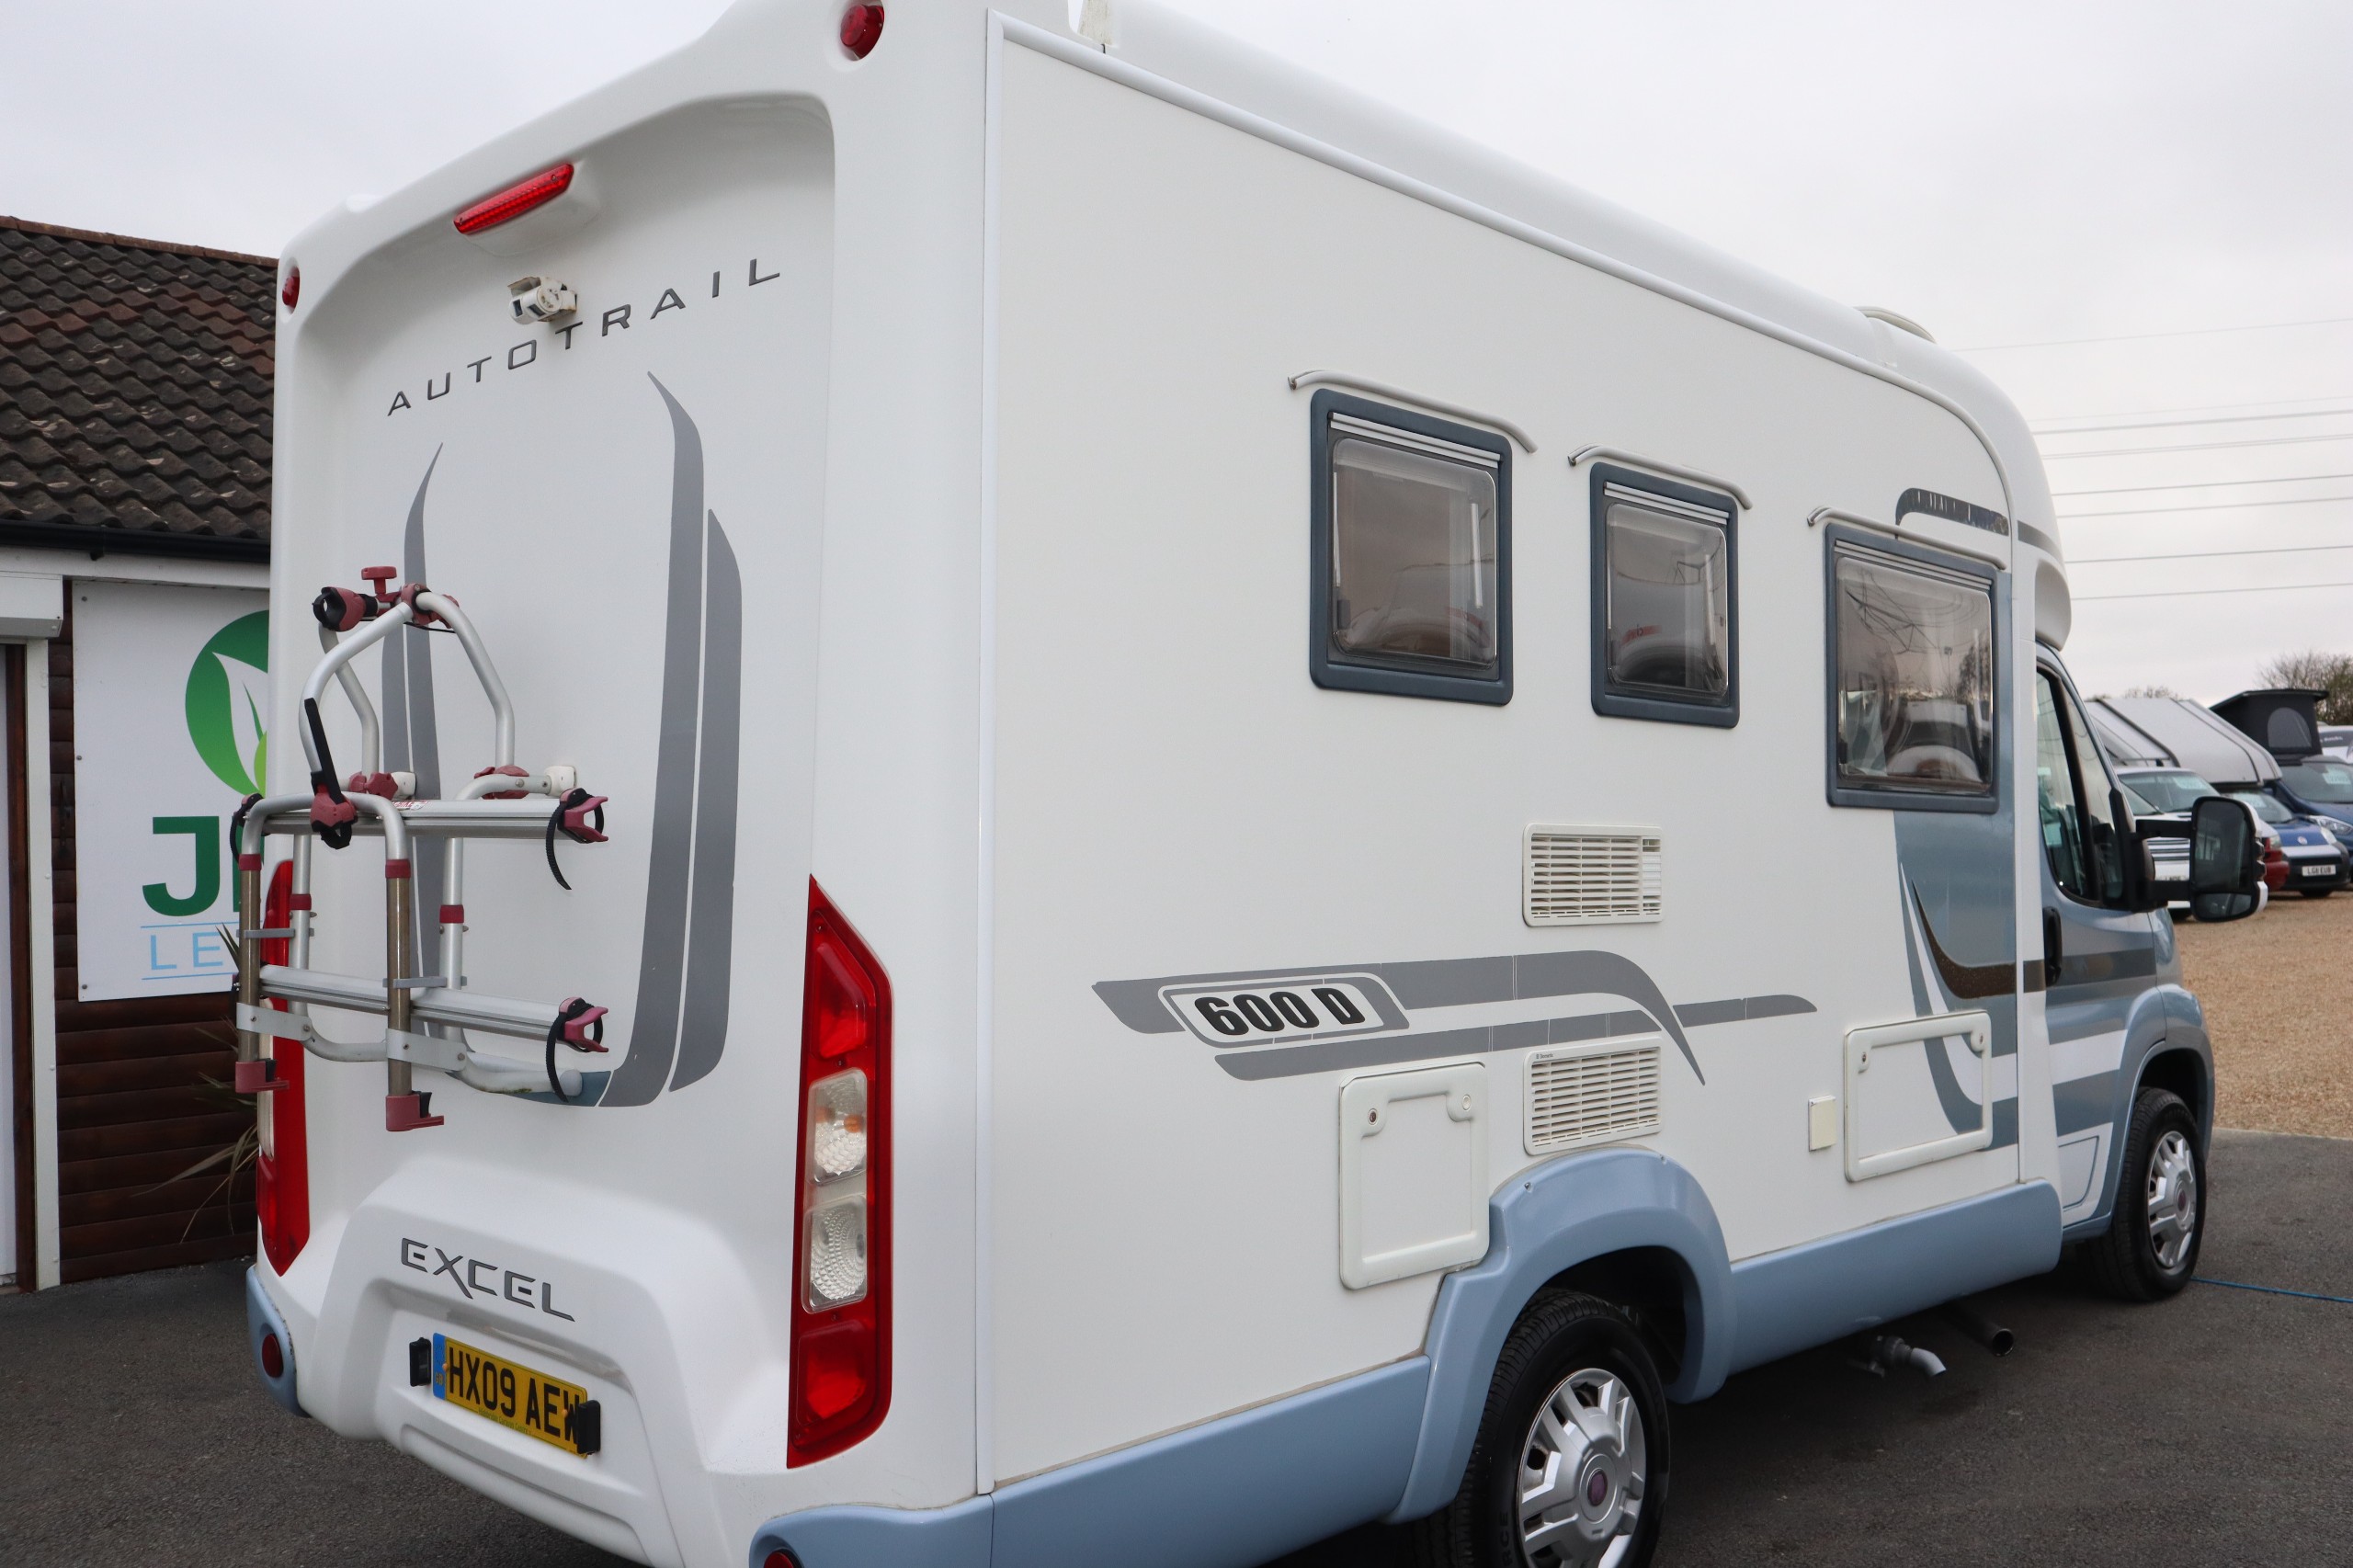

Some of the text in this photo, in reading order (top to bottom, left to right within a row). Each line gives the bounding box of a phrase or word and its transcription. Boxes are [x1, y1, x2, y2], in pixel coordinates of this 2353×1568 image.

[387, 258, 780, 416] AUTOTRAIL
[1194, 987, 1366, 1036] 600 D
[401, 1237, 575, 1323] EXCEL
[449, 1346, 517, 1418] HX09
